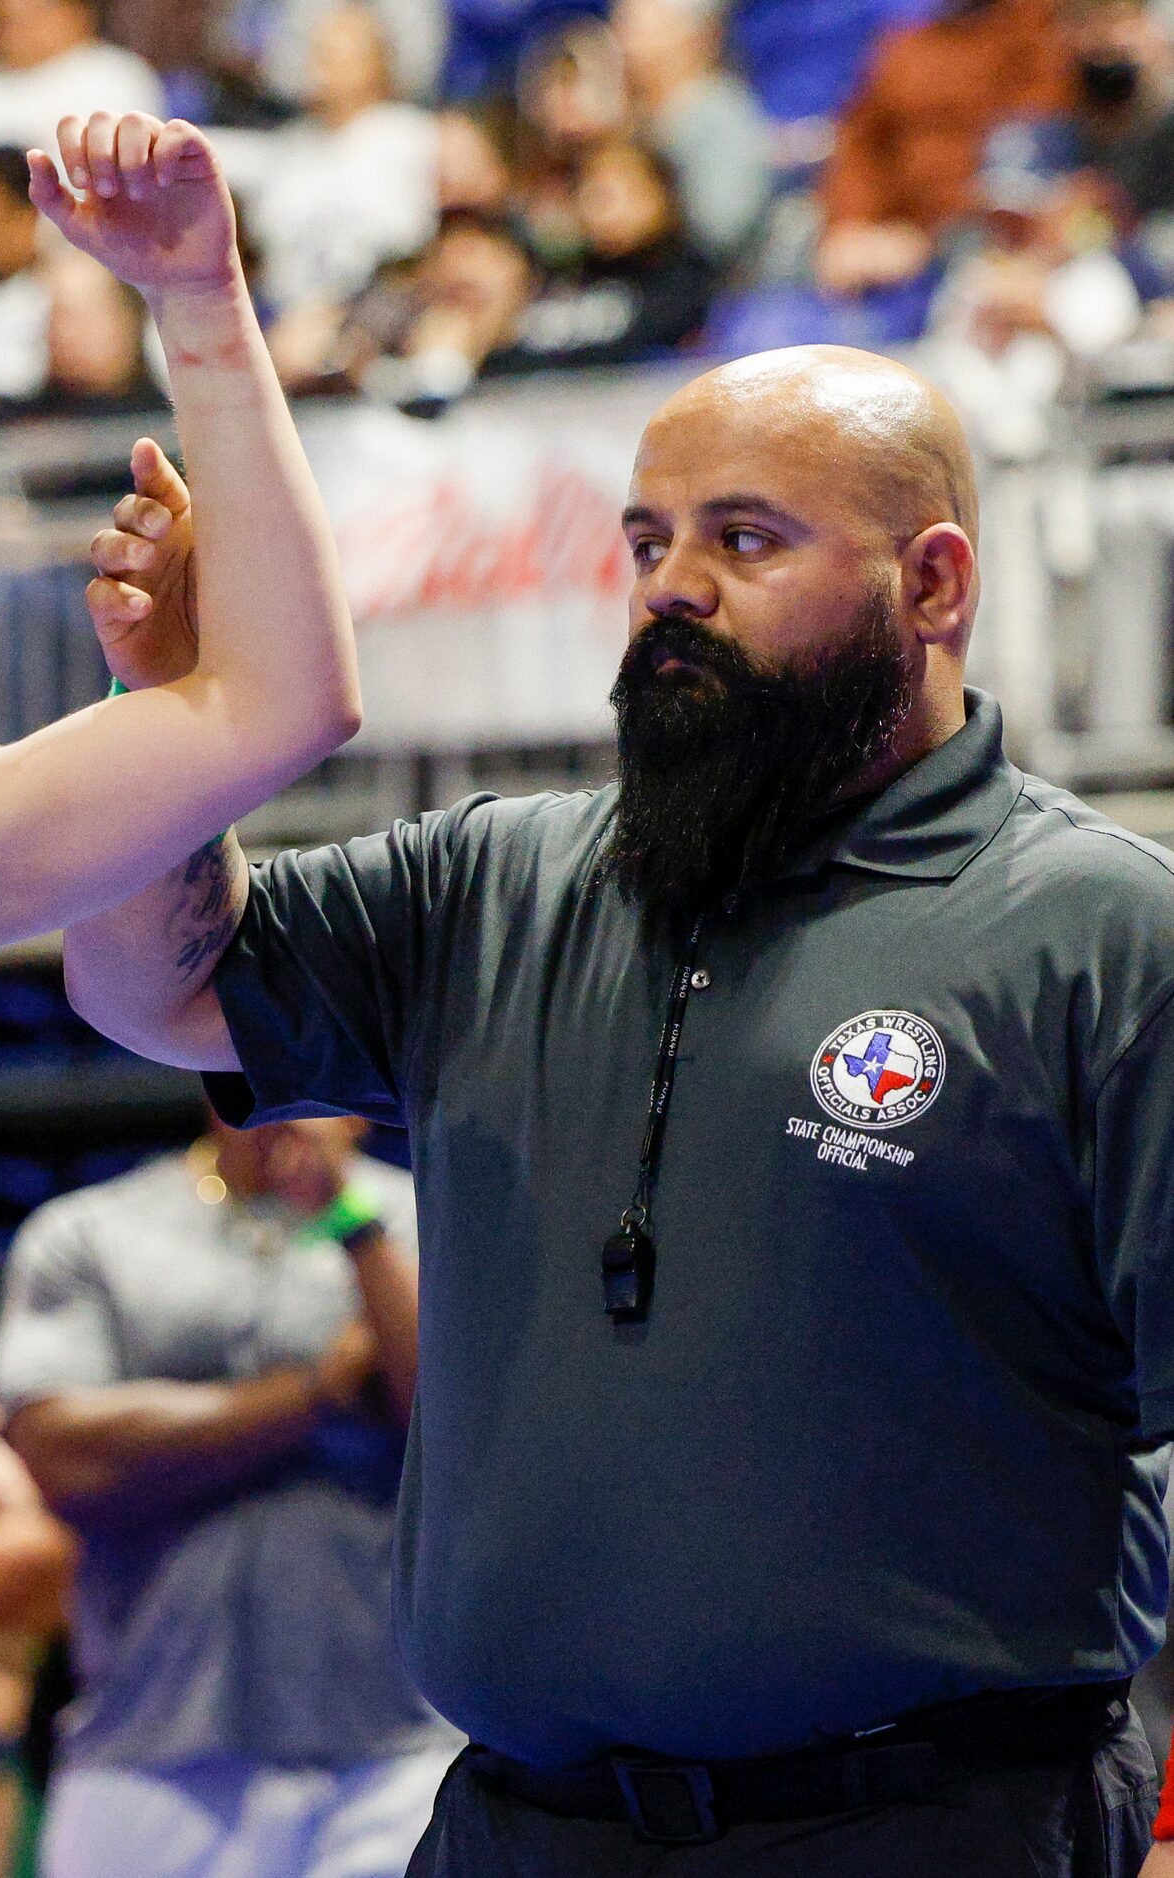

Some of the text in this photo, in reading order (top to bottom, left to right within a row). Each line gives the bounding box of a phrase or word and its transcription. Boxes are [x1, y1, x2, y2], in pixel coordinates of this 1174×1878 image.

[668, 1023, 680, 1057] FOX40
[829, 1015, 938, 1079] TEXAS WRESTLING
[817, 1066, 927, 1122] OFFICIALS ASSOC
[785, 1117, 915, 1168] STATE CHAMPIONSHIP
[817, 1143, 868, 1171] OFFICIAL
